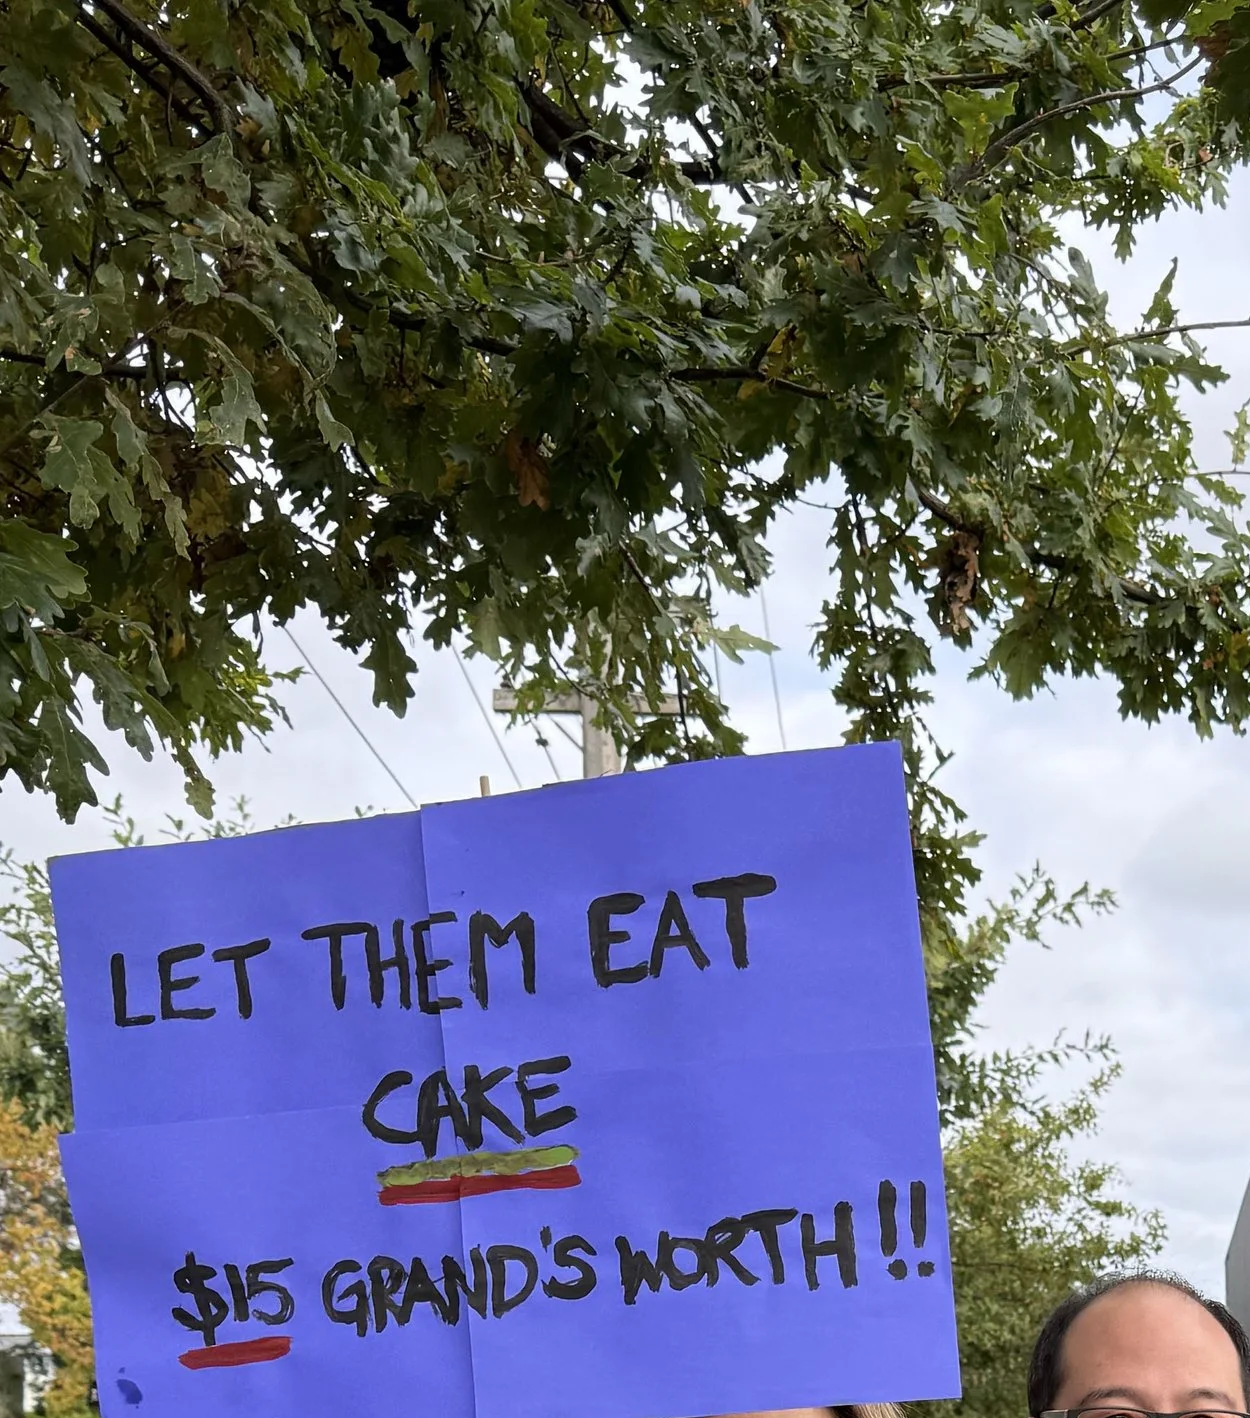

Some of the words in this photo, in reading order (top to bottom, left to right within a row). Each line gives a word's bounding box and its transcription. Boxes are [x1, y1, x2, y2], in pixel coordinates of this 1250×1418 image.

[112, 938, 271, 1027] LET
[301, 909, 538, 1015] THEM
[587, 872, 777, 988] EAT
[362, 1055, 578, 1157] CAKE
[172, 1251, 294, 1346] $15
[322, 1225, 597, 1337] GRAND'S
